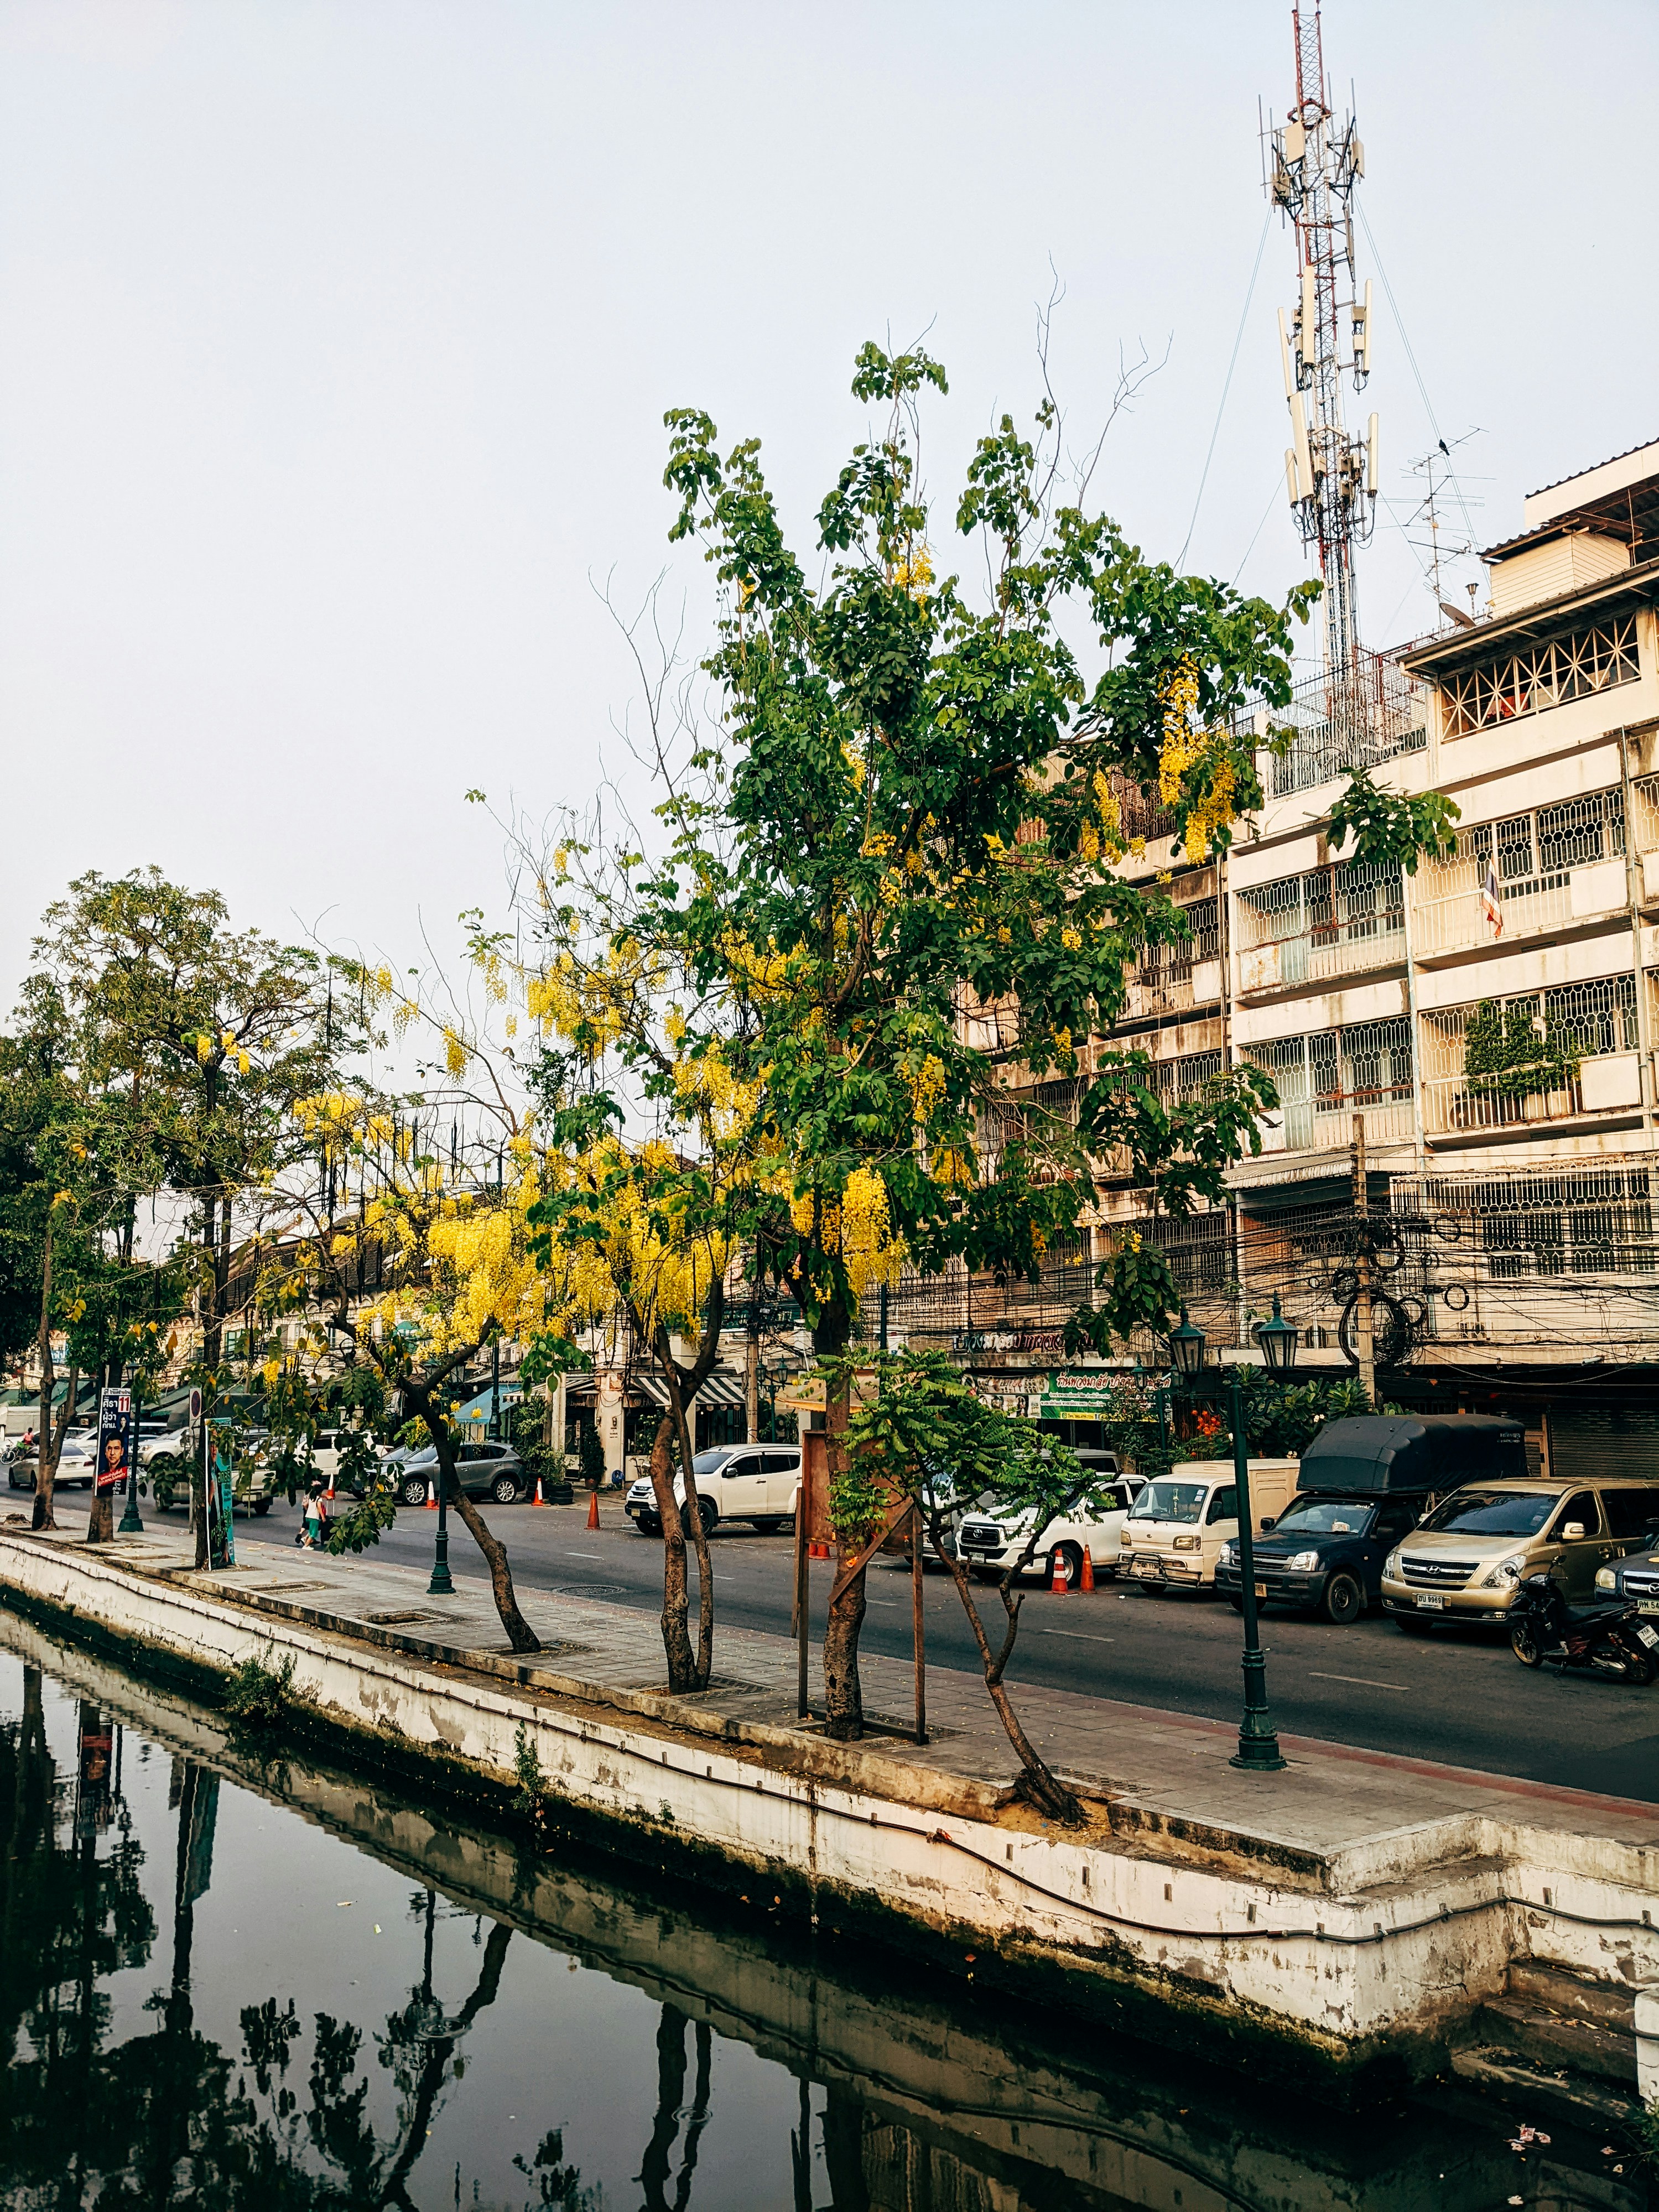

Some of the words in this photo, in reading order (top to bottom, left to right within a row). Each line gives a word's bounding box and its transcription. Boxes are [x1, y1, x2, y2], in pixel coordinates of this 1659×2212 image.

[119, 1397, 129, 1411] 11
[103, 1411, 117, 1423] ผู้ว่า
